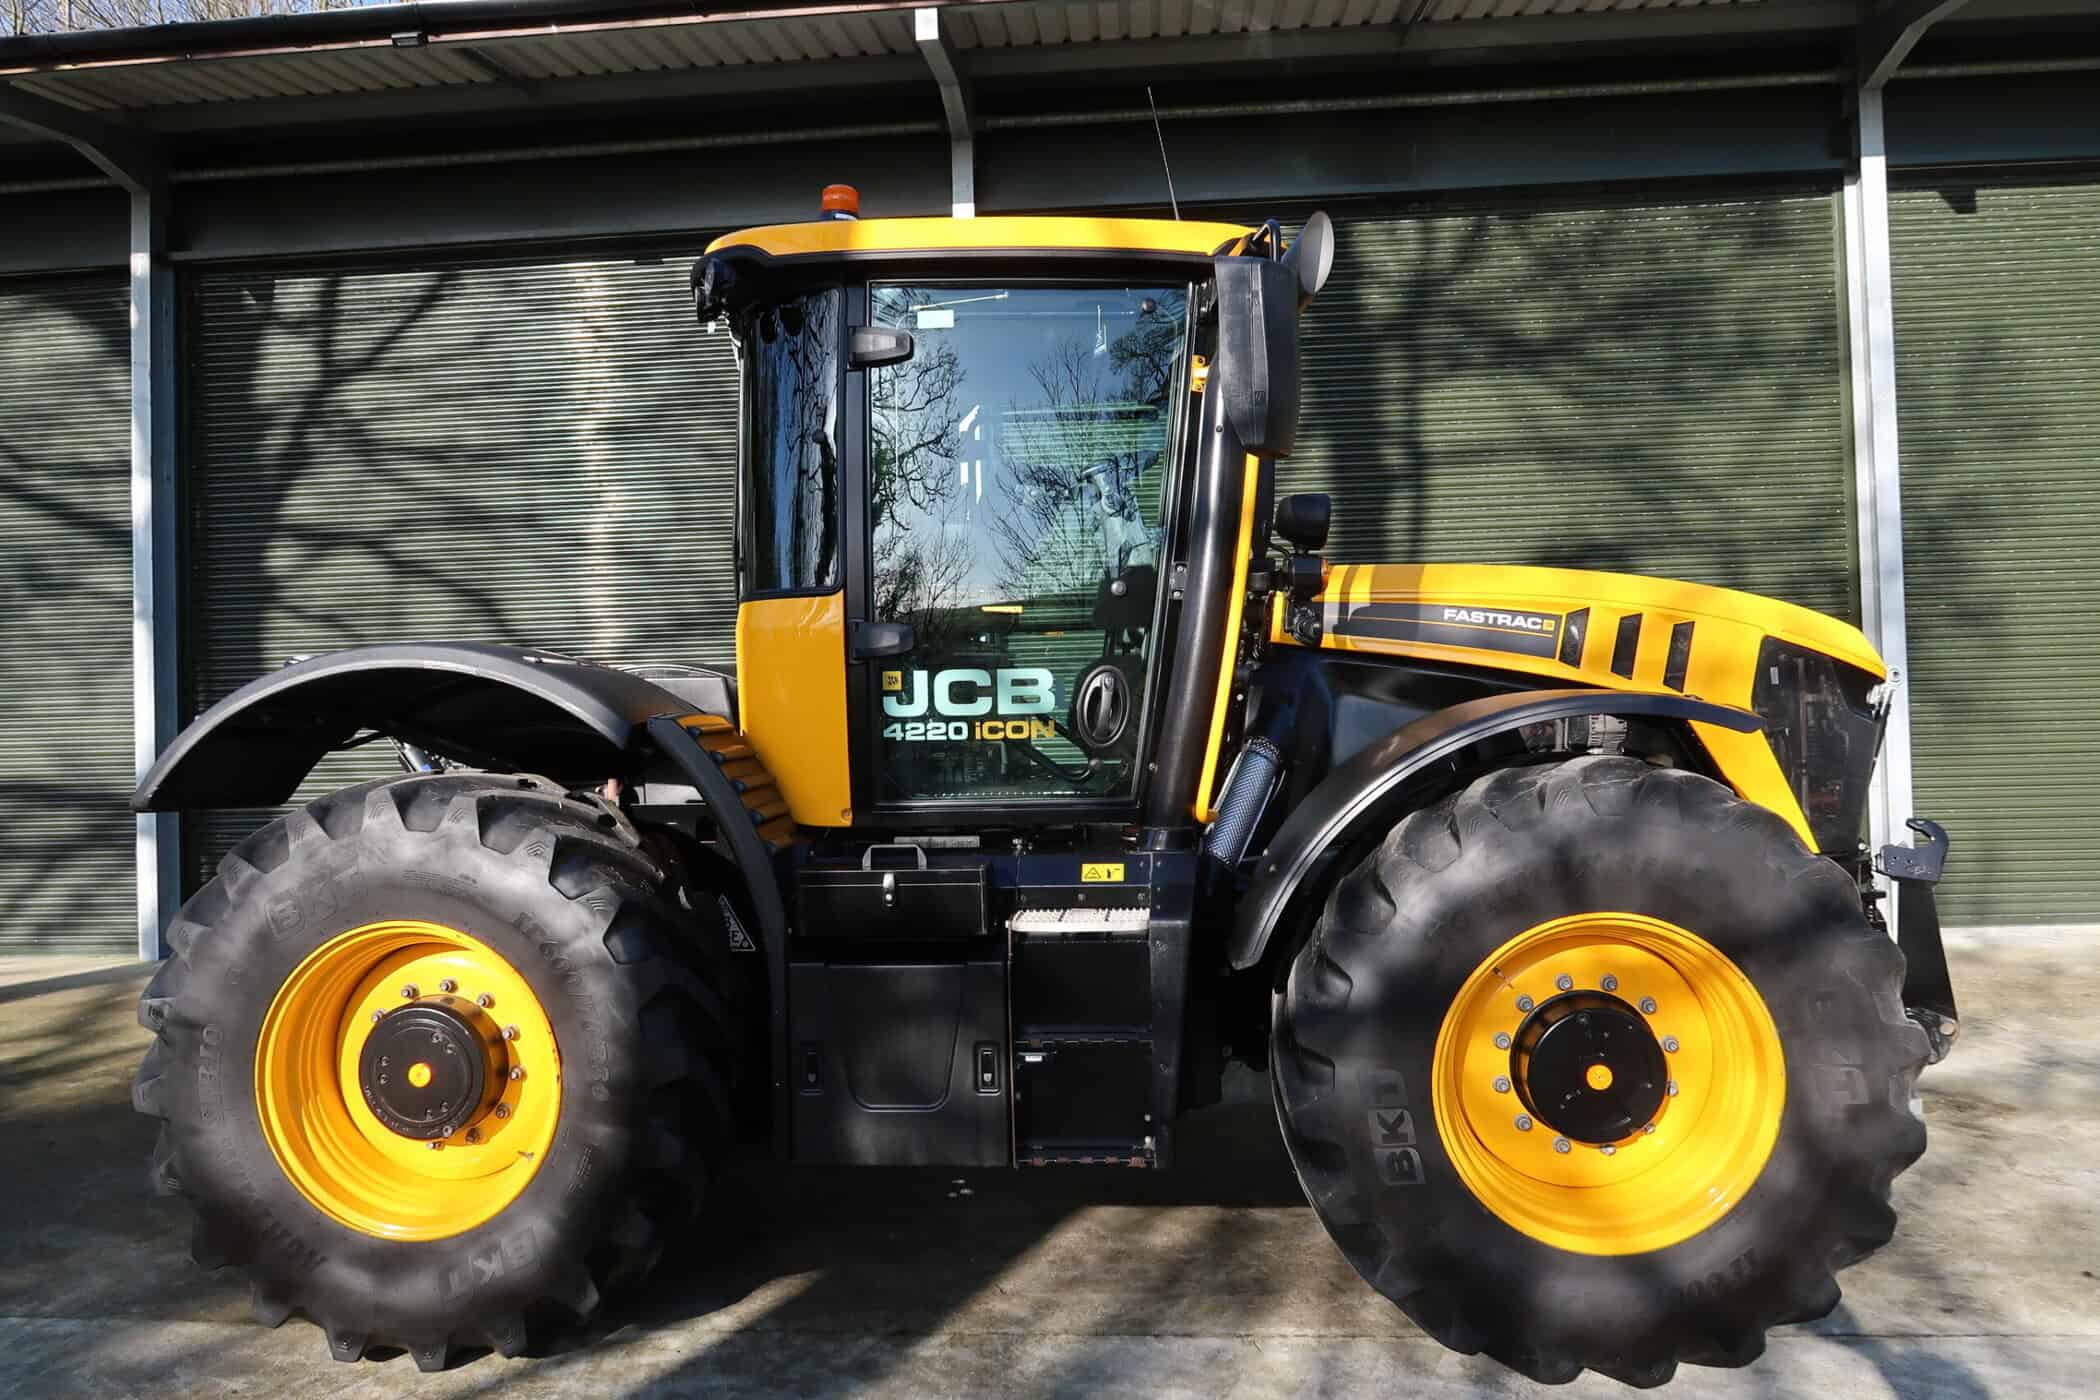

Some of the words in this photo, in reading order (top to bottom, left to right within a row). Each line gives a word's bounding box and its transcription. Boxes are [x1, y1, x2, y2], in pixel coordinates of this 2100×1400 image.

[1442, 608, 1542, 630] FASTRAC
[883, 668, 1056, 718] JCB
[883, 720, 969, 742] 4220
[975, 719, 1056, 741] iCON
